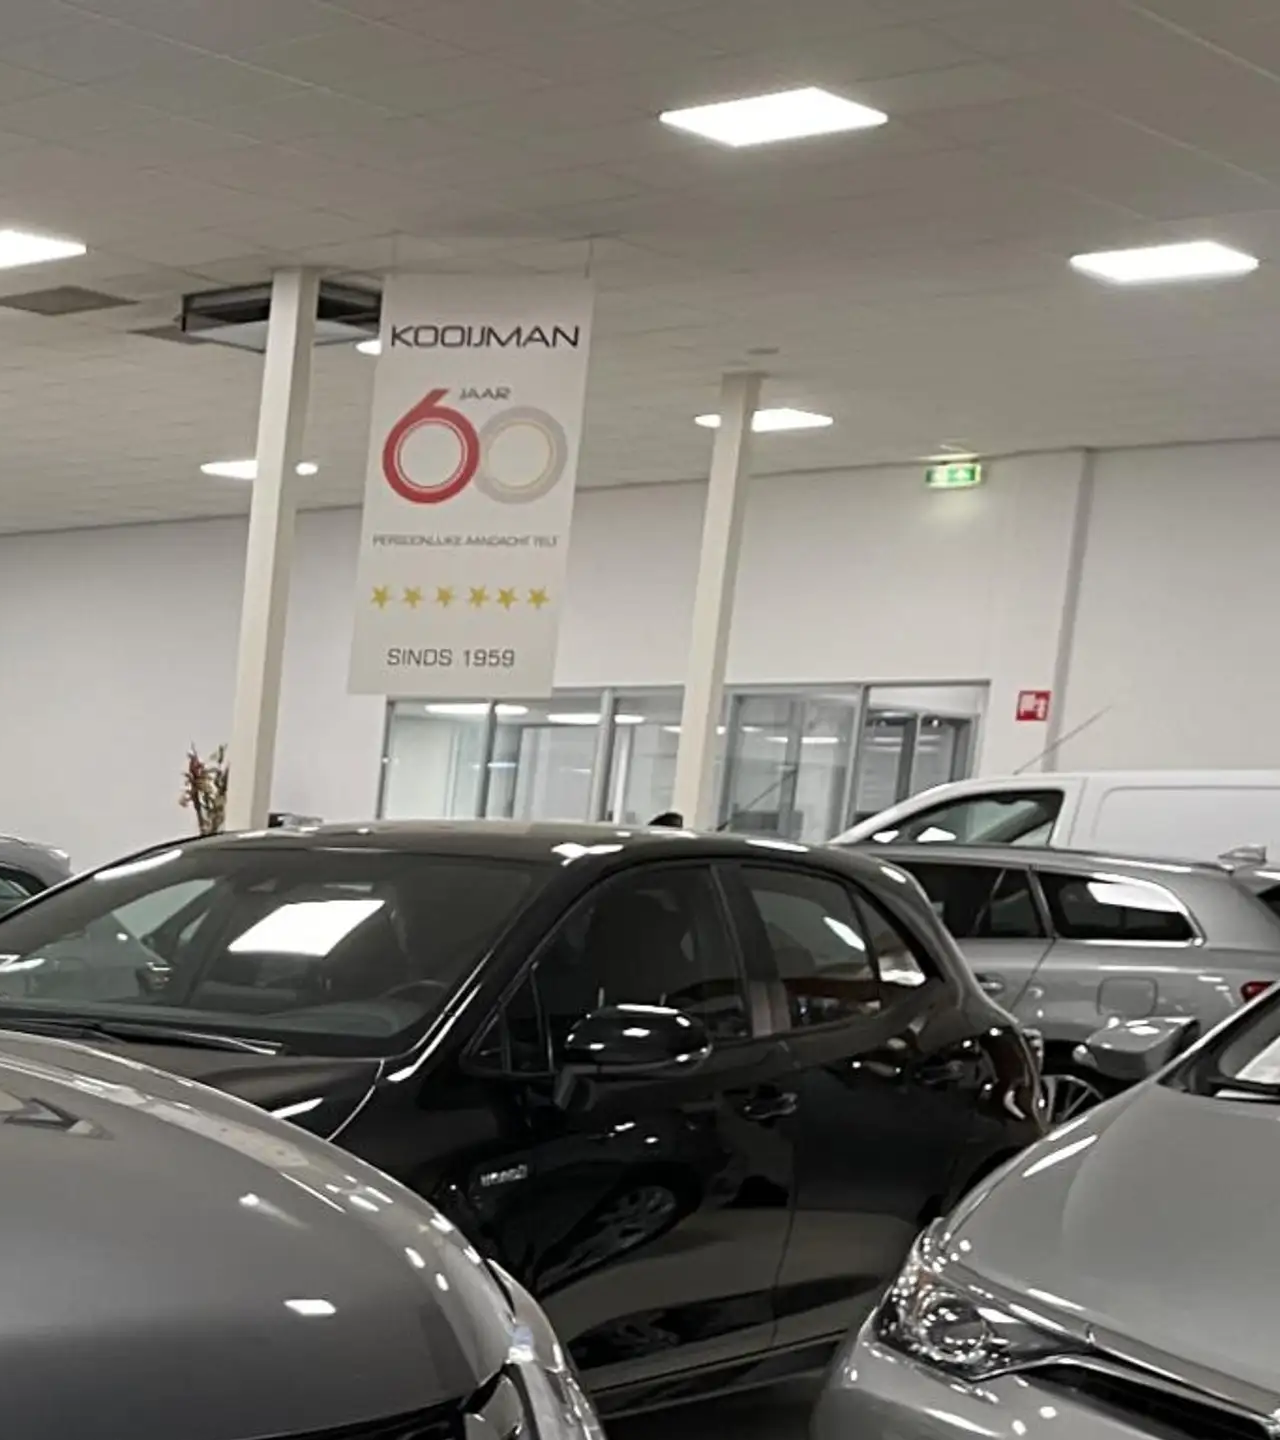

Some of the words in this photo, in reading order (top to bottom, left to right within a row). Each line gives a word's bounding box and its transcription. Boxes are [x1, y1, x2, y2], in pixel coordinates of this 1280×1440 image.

[391, 325, 579, 348] KOOIJMAN
[459, 387, 511, 401] JAAR
[382, 388, 568, 505] 60
[387, 649, 452, 667] SINDS
[464, 650, 515, 668] 1959
